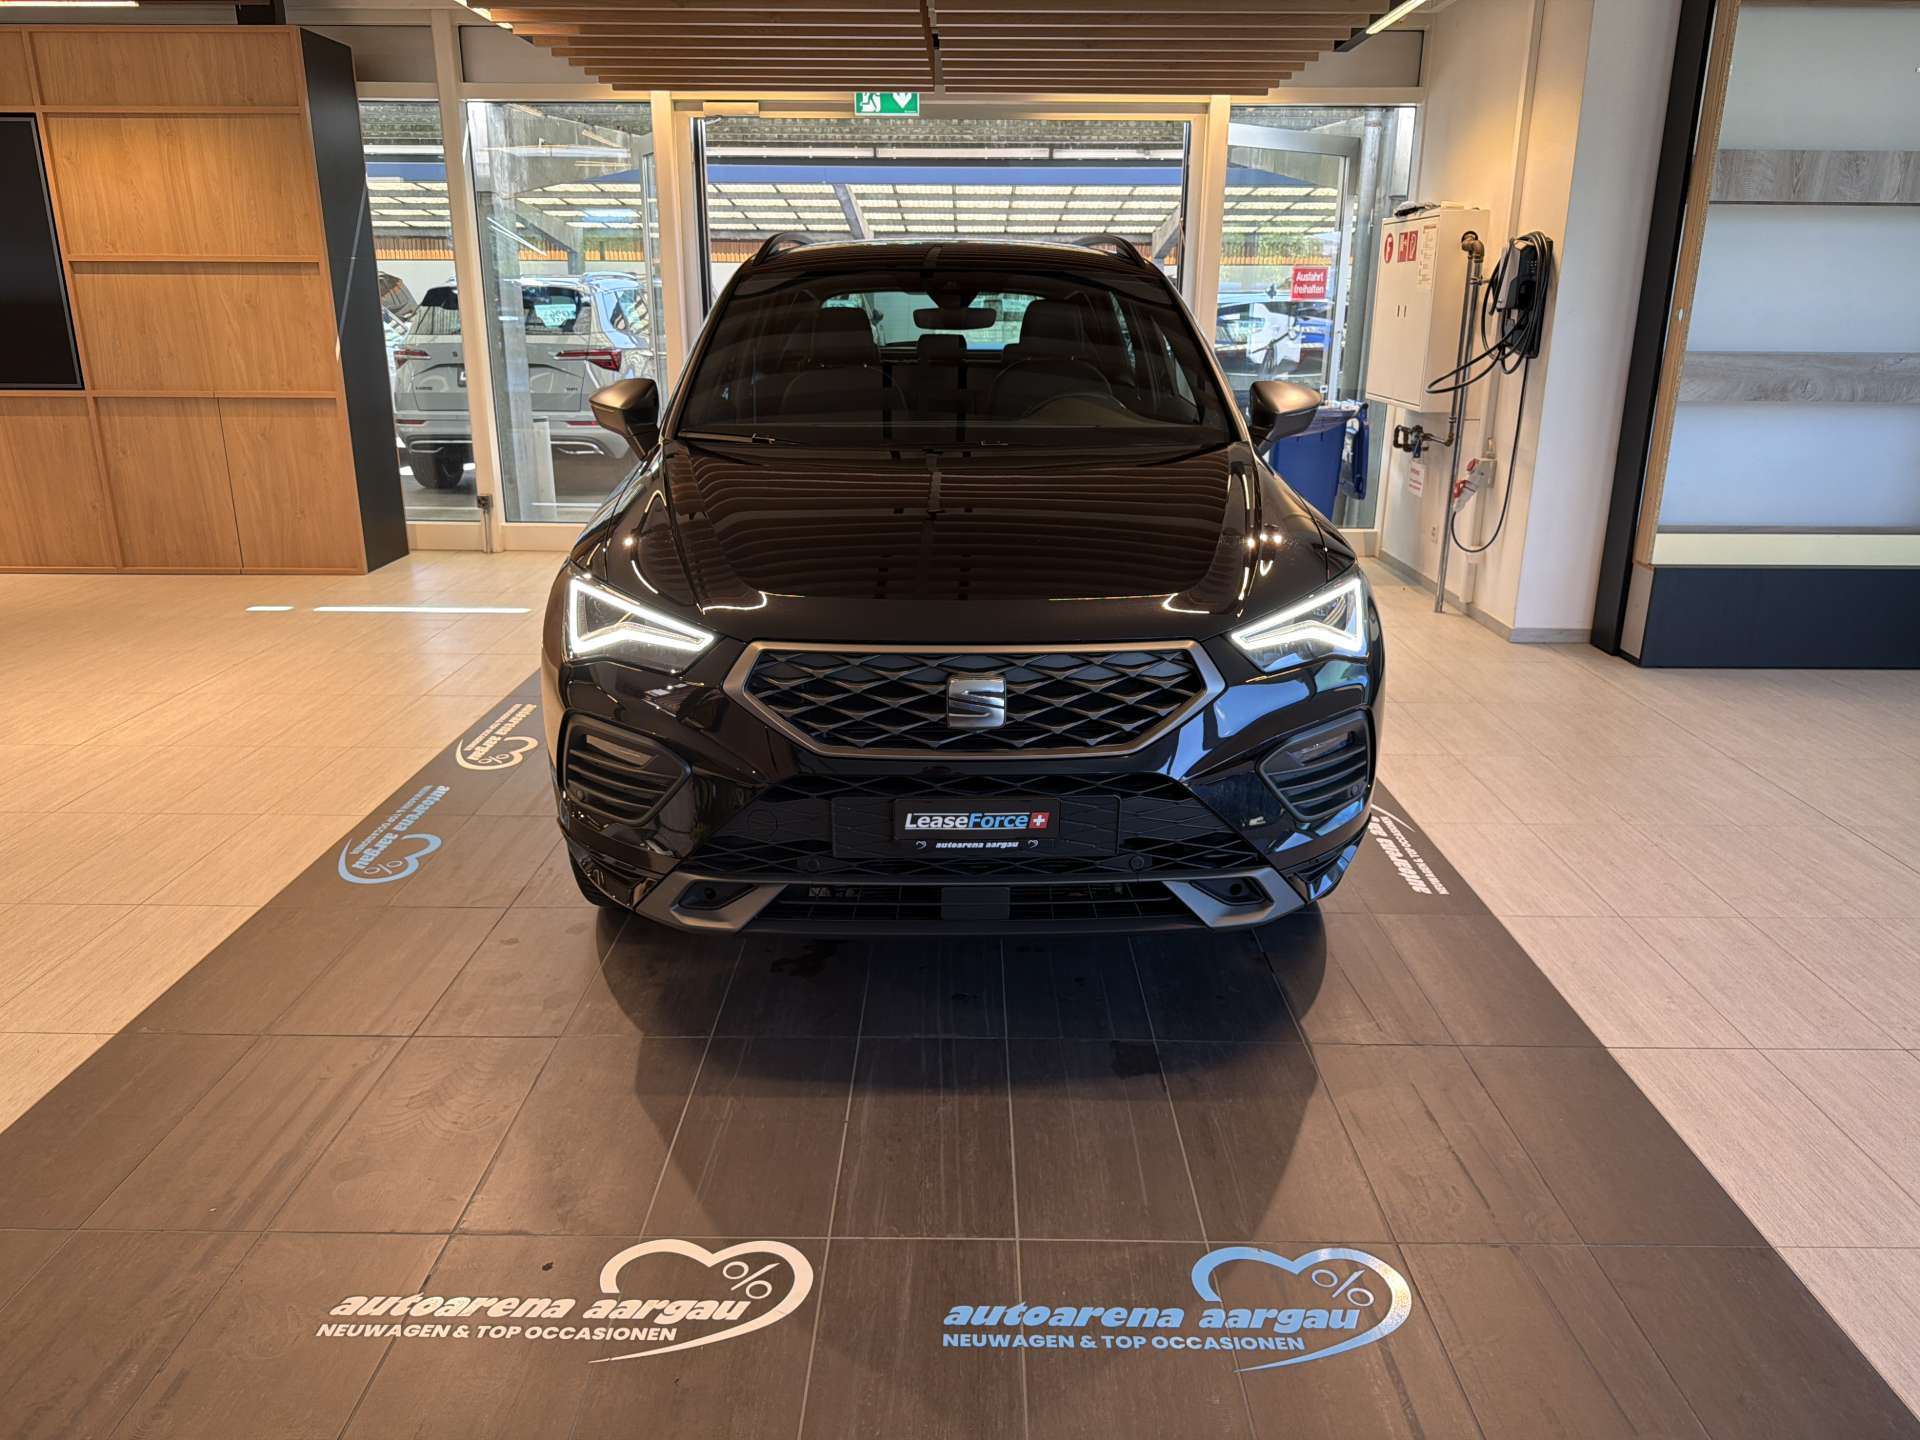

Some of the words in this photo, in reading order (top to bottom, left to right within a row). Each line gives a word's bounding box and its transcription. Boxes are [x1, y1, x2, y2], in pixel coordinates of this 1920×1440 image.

[905, 812, 1029, 829] LeaseForce
[329, 1292, 576, 1320] autoarena
[583, 1298, 751, 1325] aargau
[943, 1302, 1184, 1328] autoarena
[1198, 1307, 1360, 1334] aargau
[316, 1323, 451, 1339] NEUWAGEN
[453, 1325, 469, 1339] &
[477, 1326, 525, 1339] TOP
[526, 1326, 677, 1342] OCCASIONEN
[942, 1333, 1075, 1348] NEUWAGEN
[1080, 1335, 1098, 1348] &
[1102, 1335, 1146, 1349] TOP
[1151, 1336, 1306, 1352] OCCASIONEN
